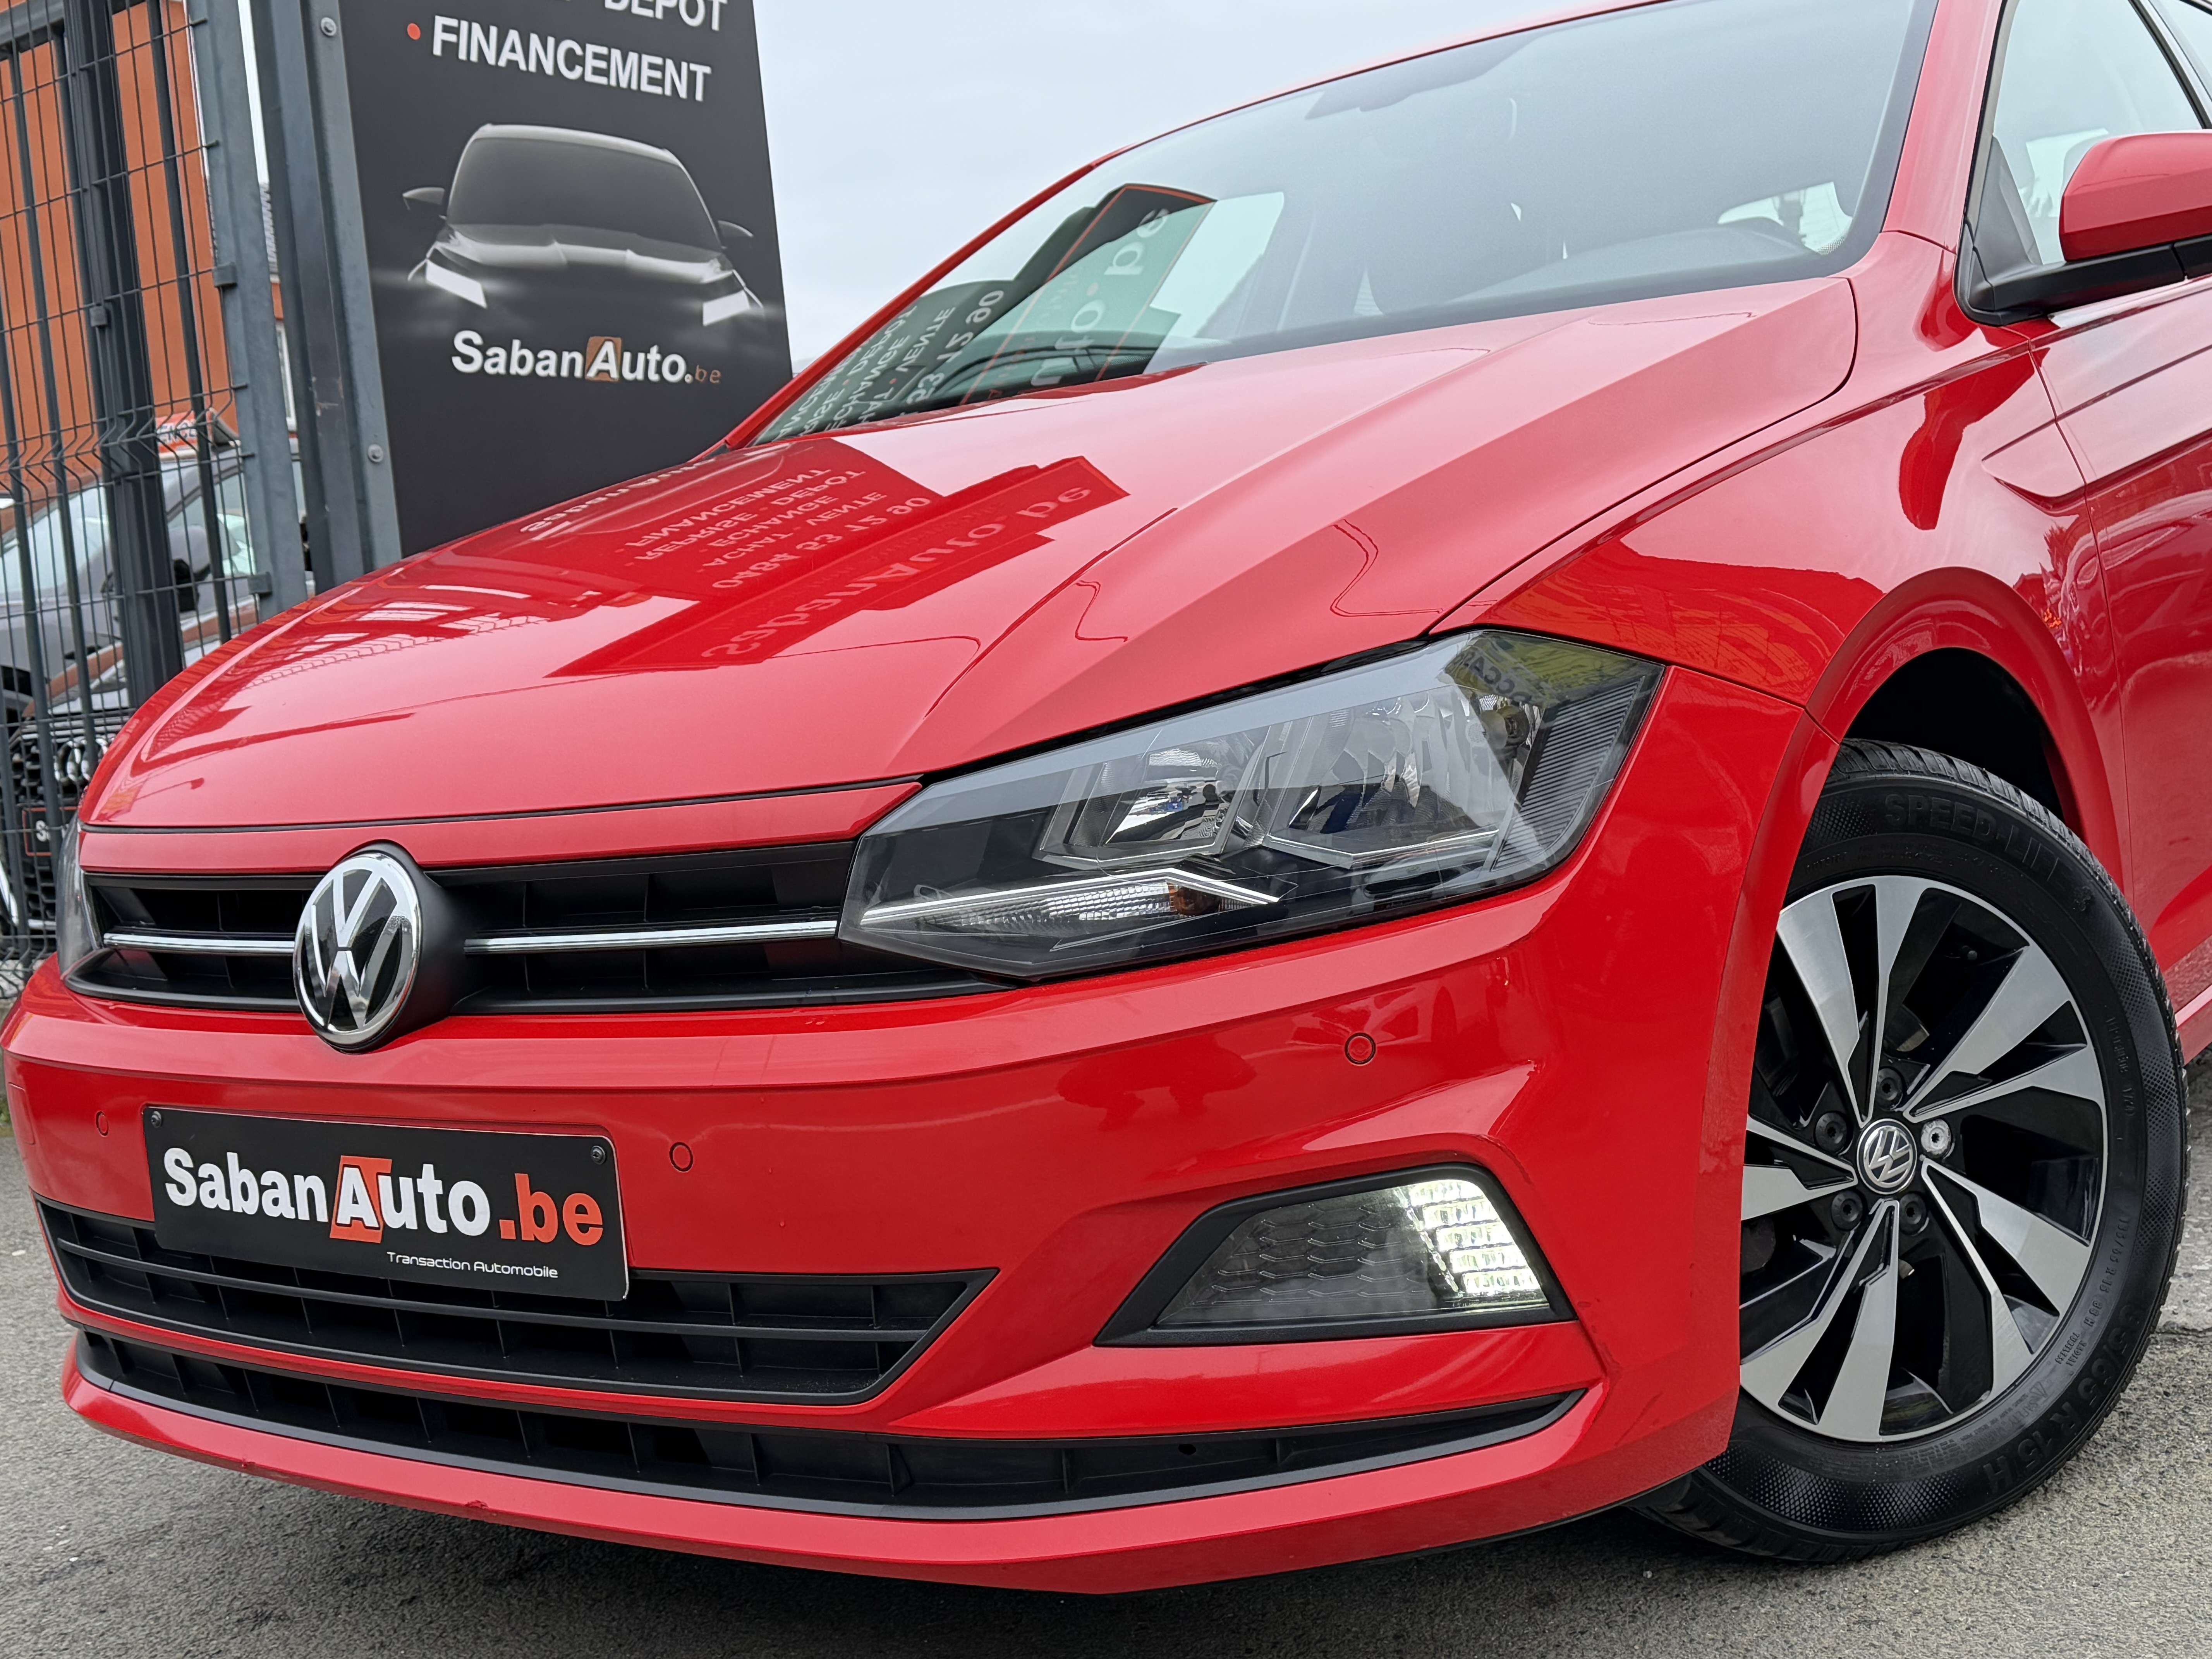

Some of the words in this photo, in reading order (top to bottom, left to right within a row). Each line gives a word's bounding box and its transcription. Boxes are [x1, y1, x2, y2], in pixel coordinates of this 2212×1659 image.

[433, 15, 711, 101] FINANCEMENT
[387, 1252, 470, 1271] Transaction
[474, 1262, 558, 1279] Automobile
